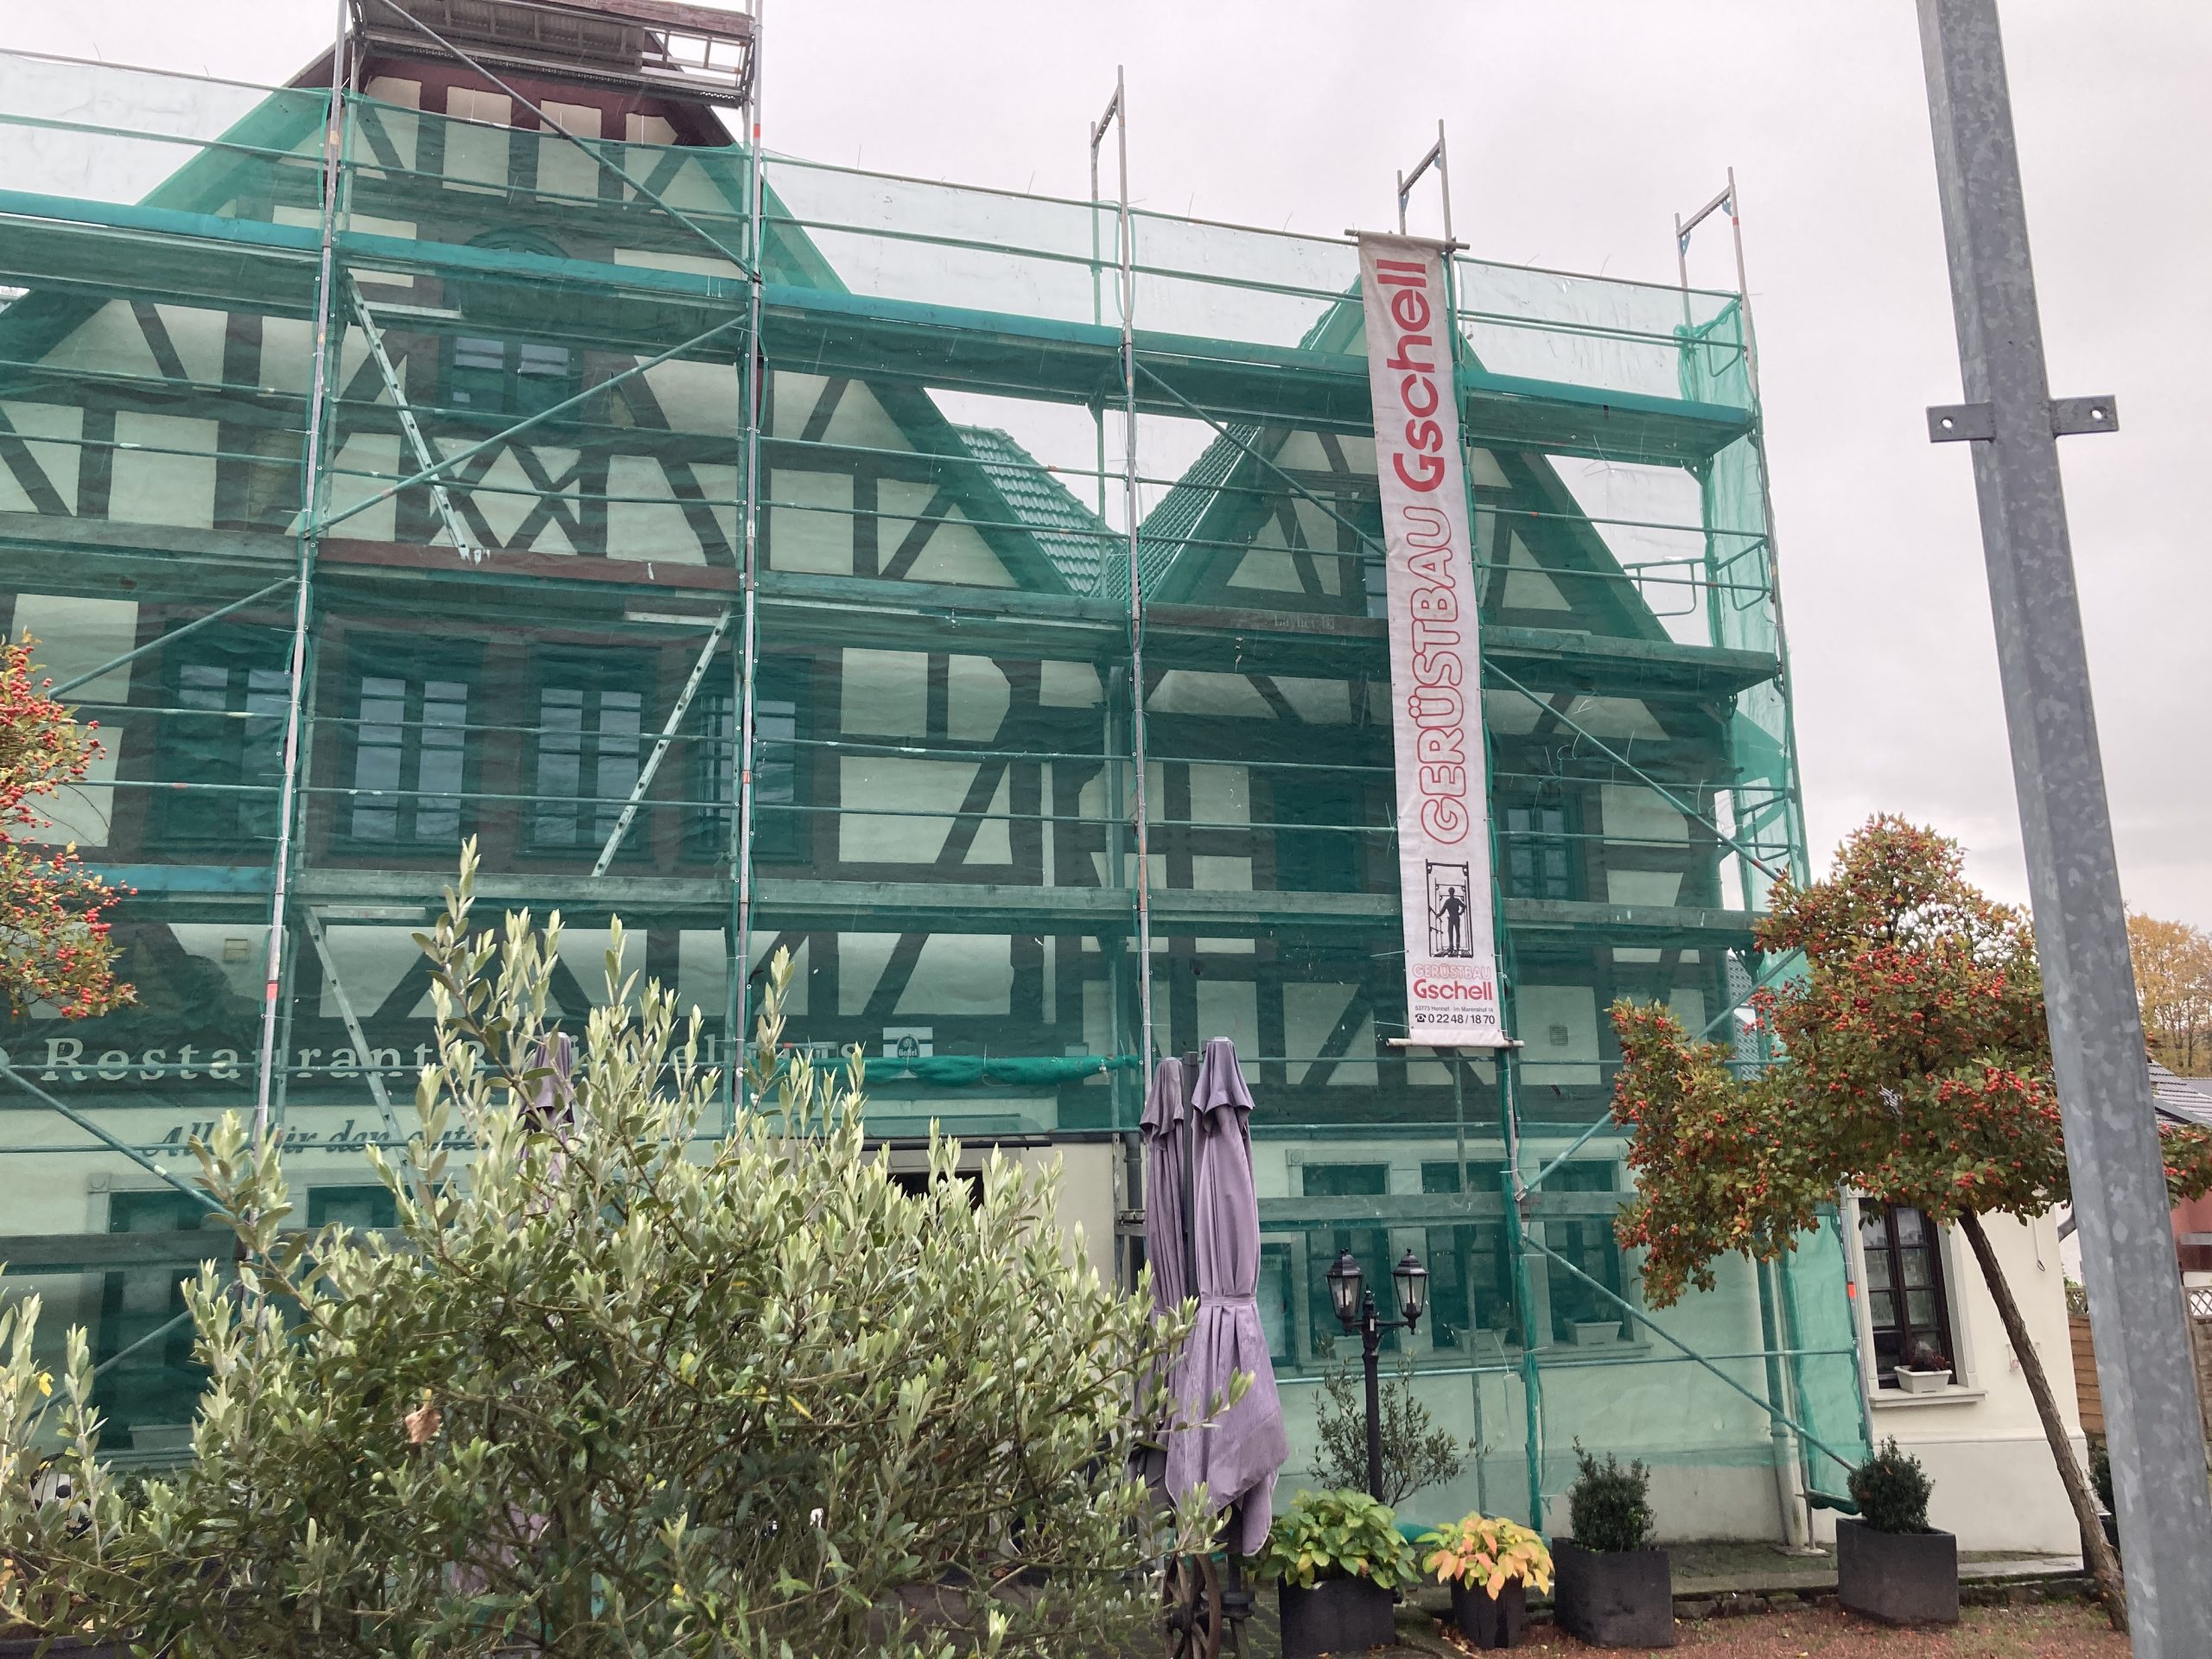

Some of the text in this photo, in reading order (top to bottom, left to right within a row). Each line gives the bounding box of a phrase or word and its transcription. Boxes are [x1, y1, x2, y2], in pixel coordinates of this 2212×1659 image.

[1376, 258, 1468, 845] GERÜSTBAU Gschell
[1412, 963, 1491, 980] GERÜSTBAU
[1413, 978, 1493, 1001] Gschell
[41, 1038, 434, 1081] Restaurant
